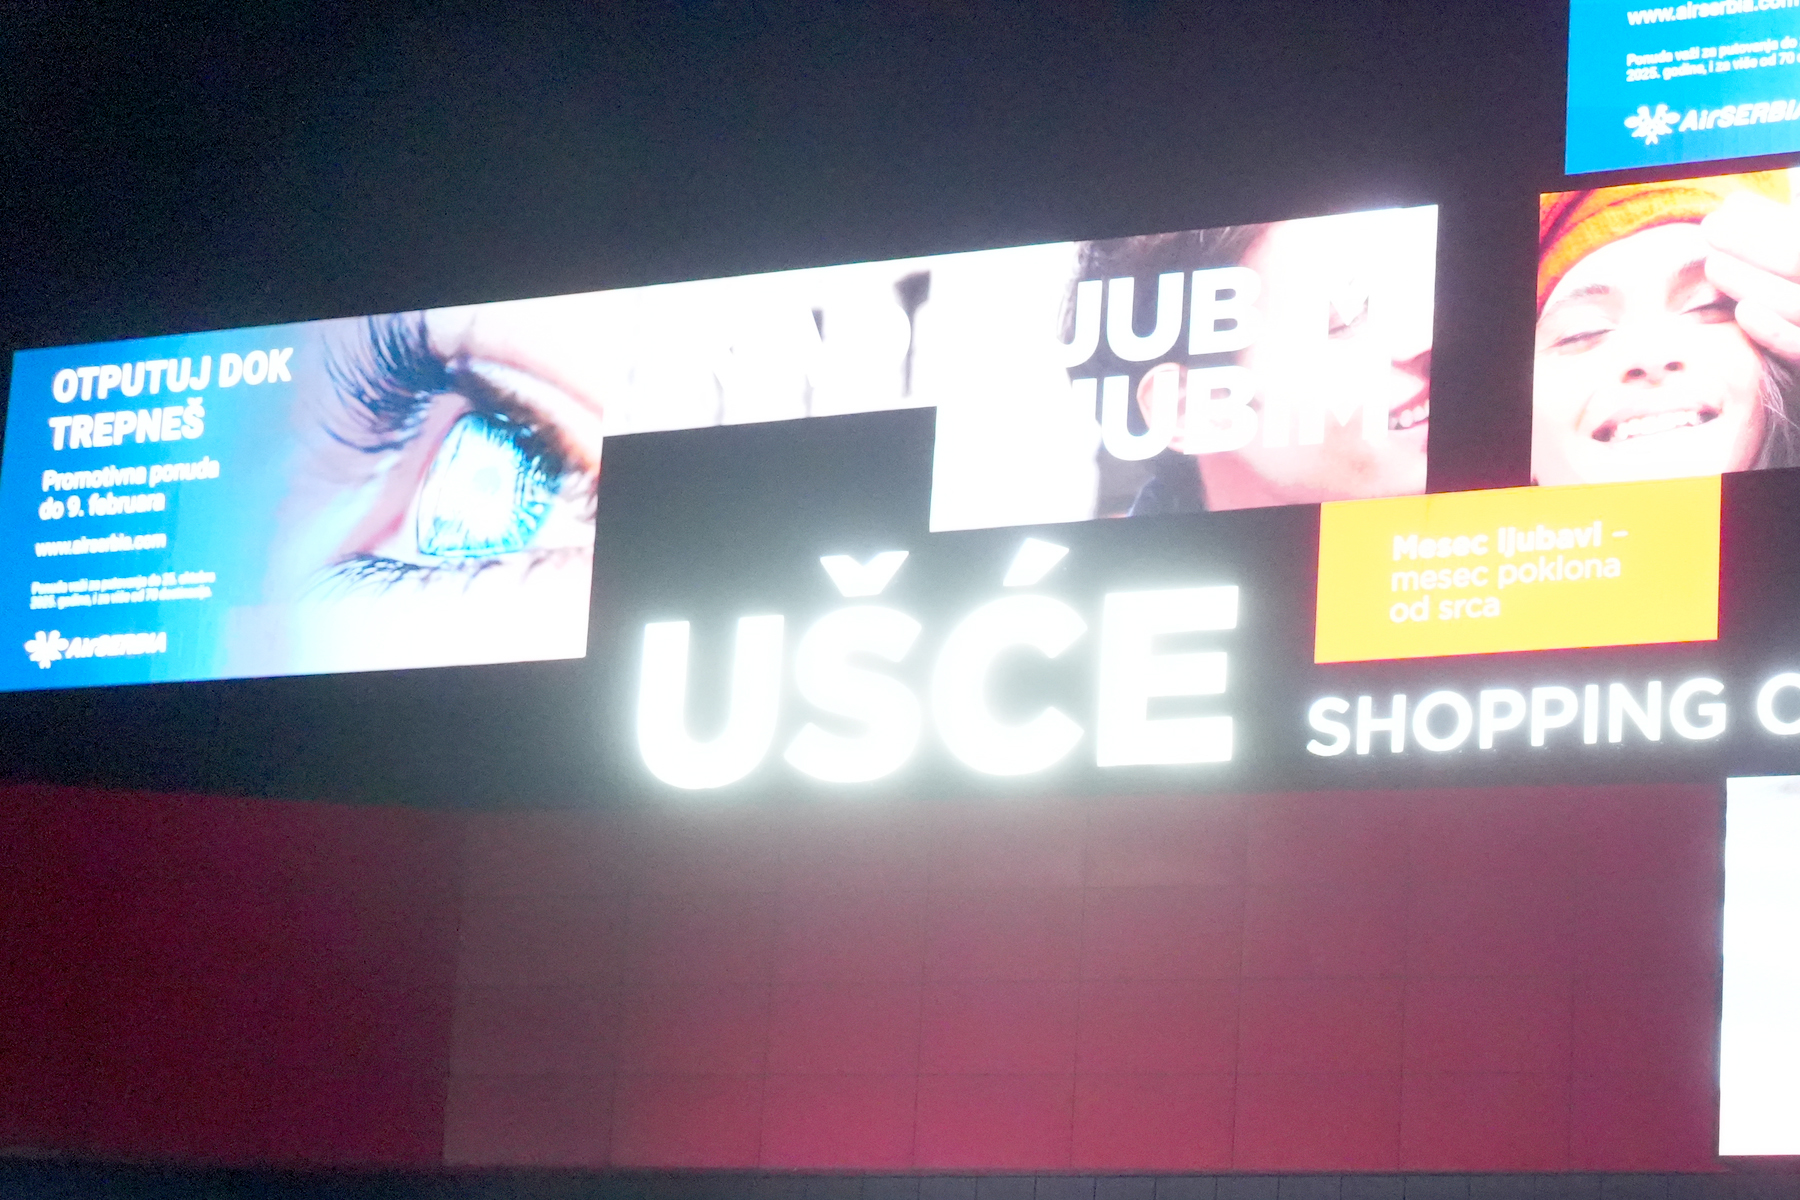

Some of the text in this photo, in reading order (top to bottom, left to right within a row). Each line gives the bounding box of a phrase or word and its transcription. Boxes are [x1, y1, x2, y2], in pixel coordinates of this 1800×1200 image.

[1781, 36, 1797, 49] do
[1627, 67, 1660, 81] 2025.
[1759, 53, 1776, 67] od
[1779, 51, 1795, 65] 70
[52, 347, 294, 403] OTPUTUJ DOK
[48, 396, 206, 451] TREPNEŠ
[149, 455, 220, 488] ponuda
[38, 496, 65, 520] do
[67, 495, 85, 517] 9.
[1392, 533, 1489, 561] Mesec
[1391, 555, 1621, 592] mesec poklona
[1389, 594, 1501, 623] od srca
[637, 538, 1239, 790] UŠĆE
[1307, 678, 1727, 757] SHOPPING
